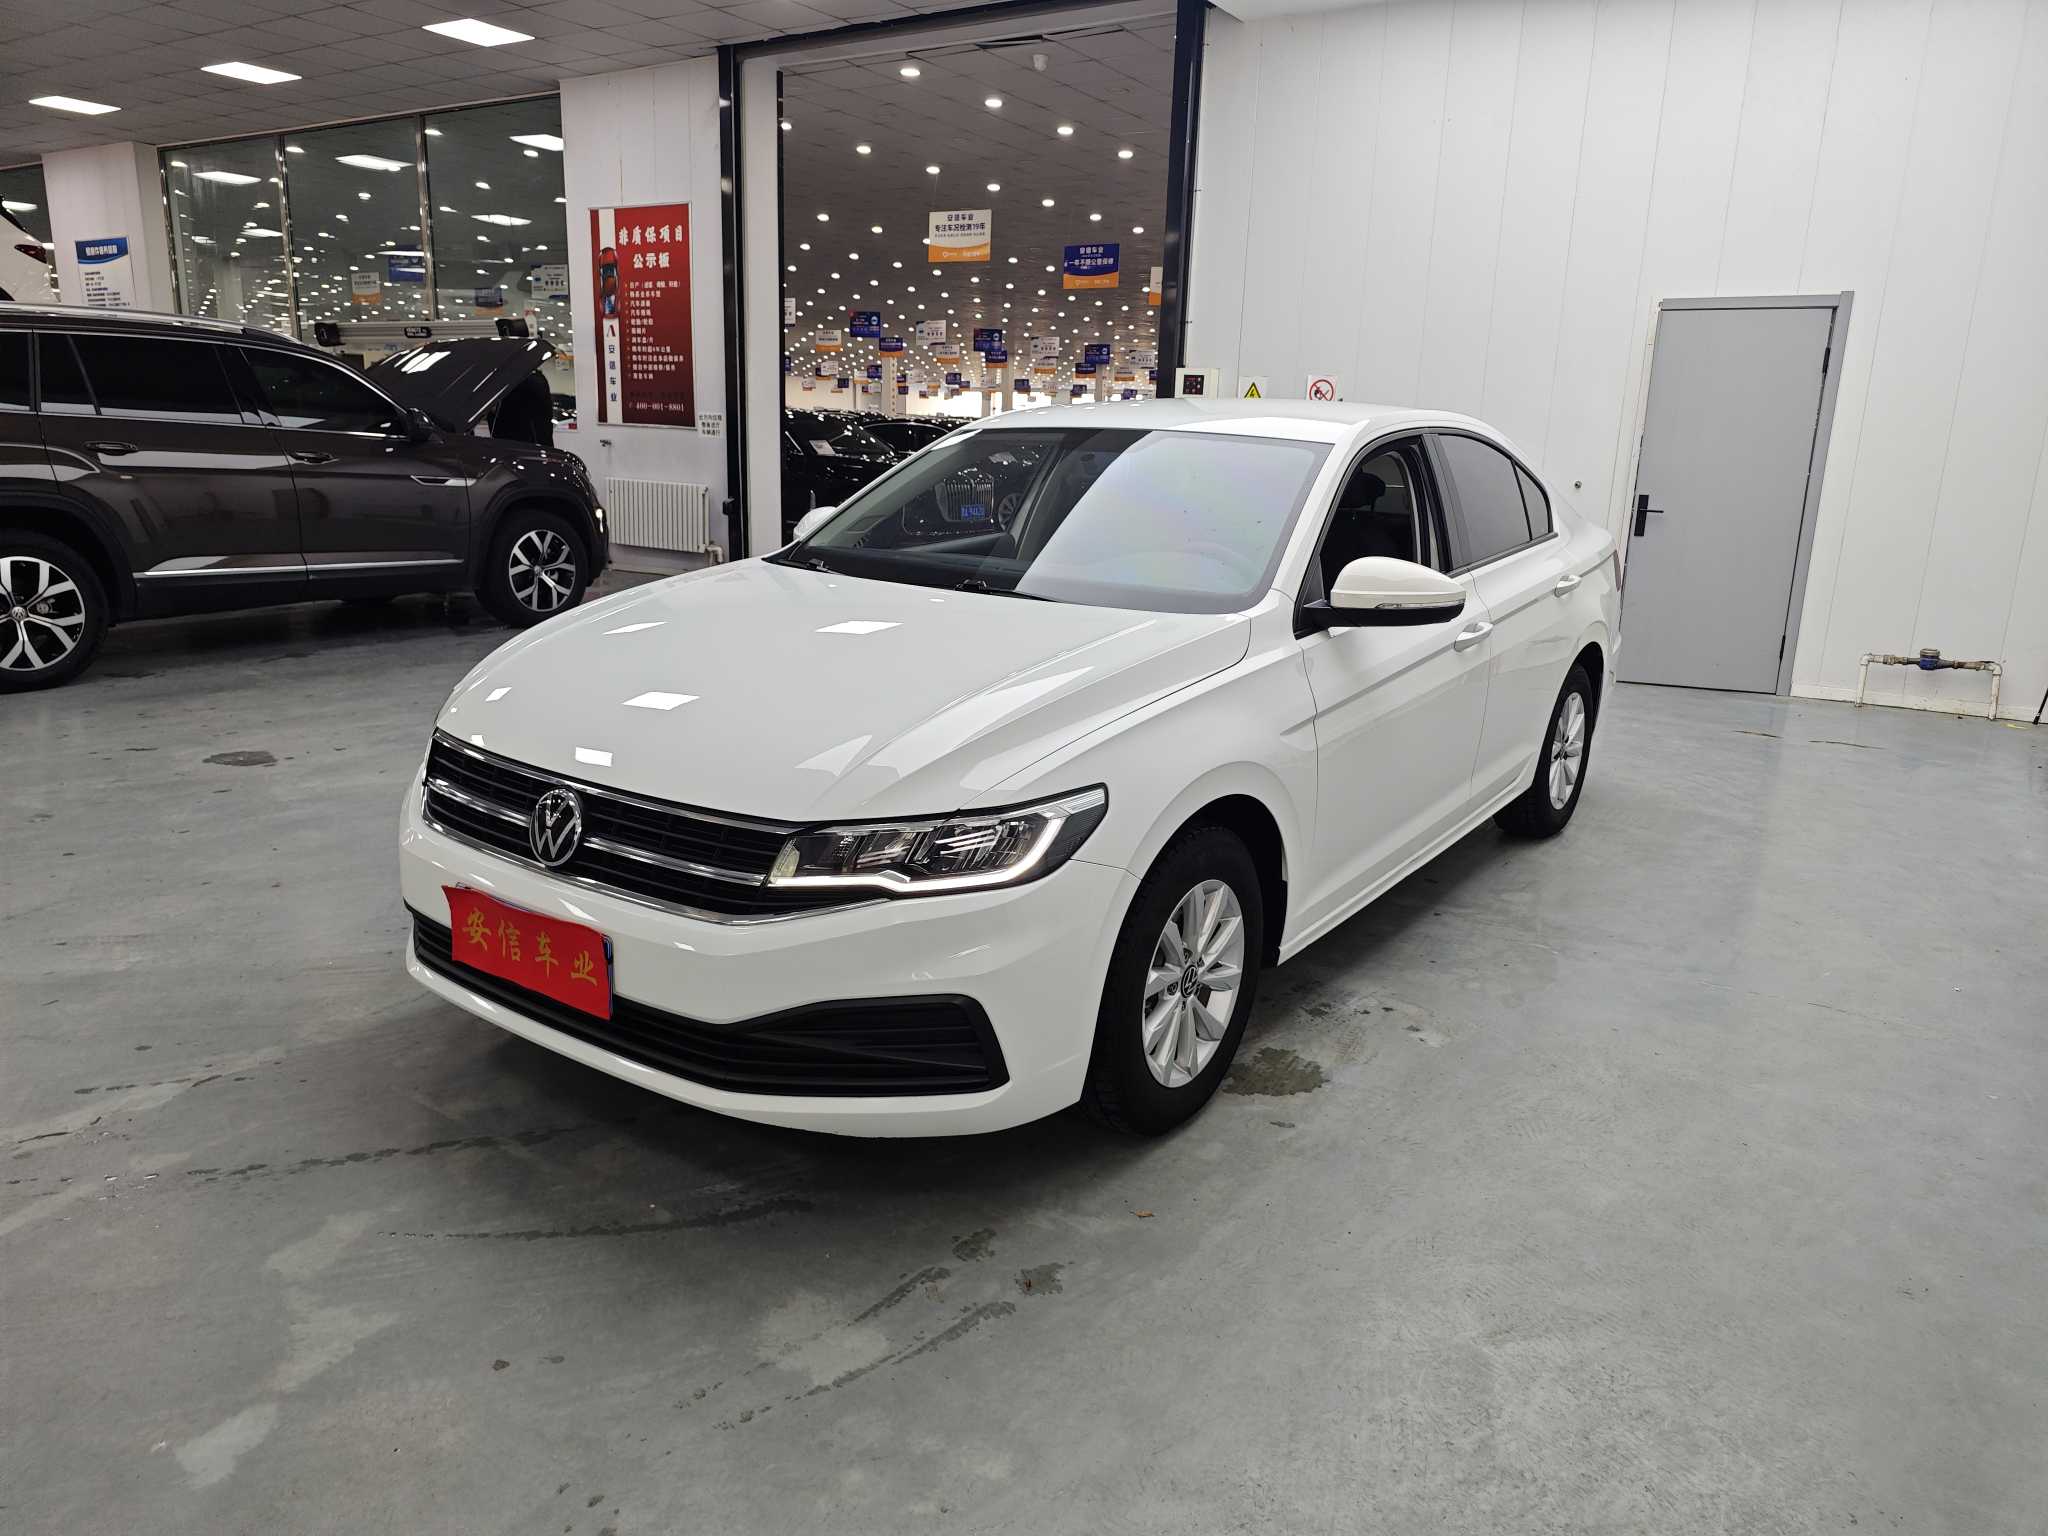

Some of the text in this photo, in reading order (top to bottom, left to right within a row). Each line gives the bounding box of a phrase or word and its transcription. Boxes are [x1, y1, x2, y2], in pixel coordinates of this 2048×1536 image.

[618, 224, 684, 246] 非质保项目
[632, 252, 671, 270] 公示板
[608, 344, 618, 402] 安信车业
[461, 907, 599, 987] 安信车业
